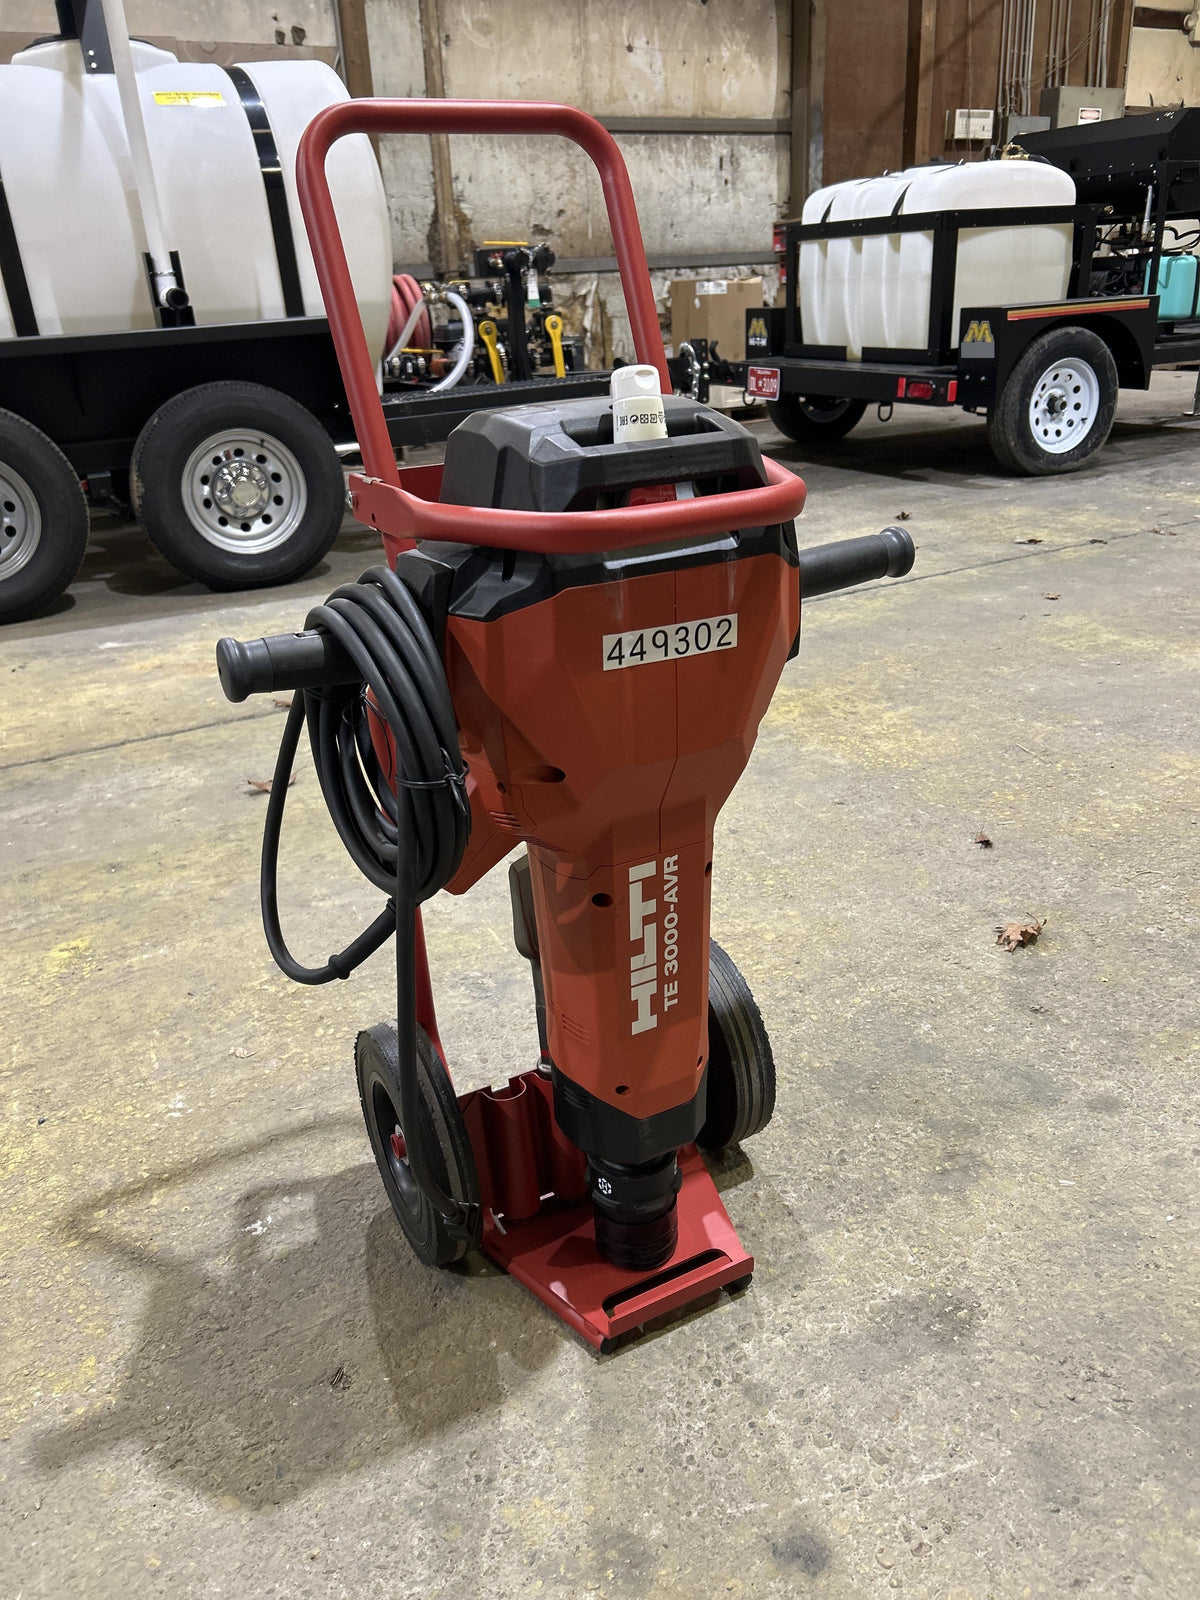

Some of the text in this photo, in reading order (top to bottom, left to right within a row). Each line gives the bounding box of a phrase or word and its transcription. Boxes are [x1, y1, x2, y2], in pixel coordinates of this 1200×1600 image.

[963, 320, 994, 343] M
[606, 618, 733, 666] 449302
[629, 860, 658, 1036] HILTI
[663, 854, 679, 1012] TE 3000-AVR
